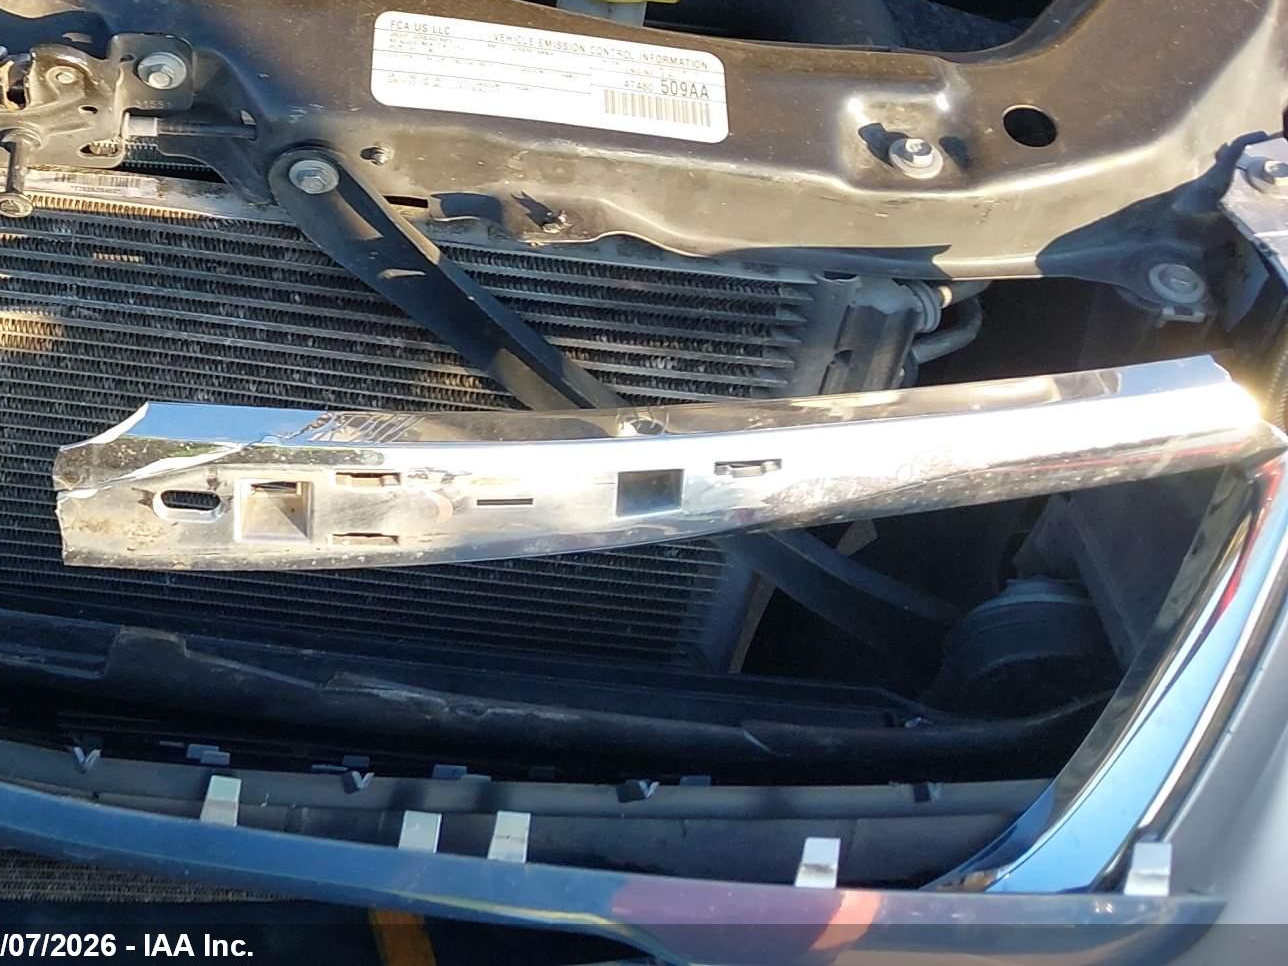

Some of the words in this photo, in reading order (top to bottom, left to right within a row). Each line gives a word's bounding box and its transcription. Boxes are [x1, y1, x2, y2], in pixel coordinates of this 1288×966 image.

[414, 22, 428, 33] US
[432, 25, 451, 35] LLC
[494, 33, 533, 47] VEHICLE
[538, 38, 586, 53] EMISSION
[590, 44, 634, 60] CONTROL
[639, 51, 709, 70] INFORMATION
[661, 79, 710, 99] 509AA
